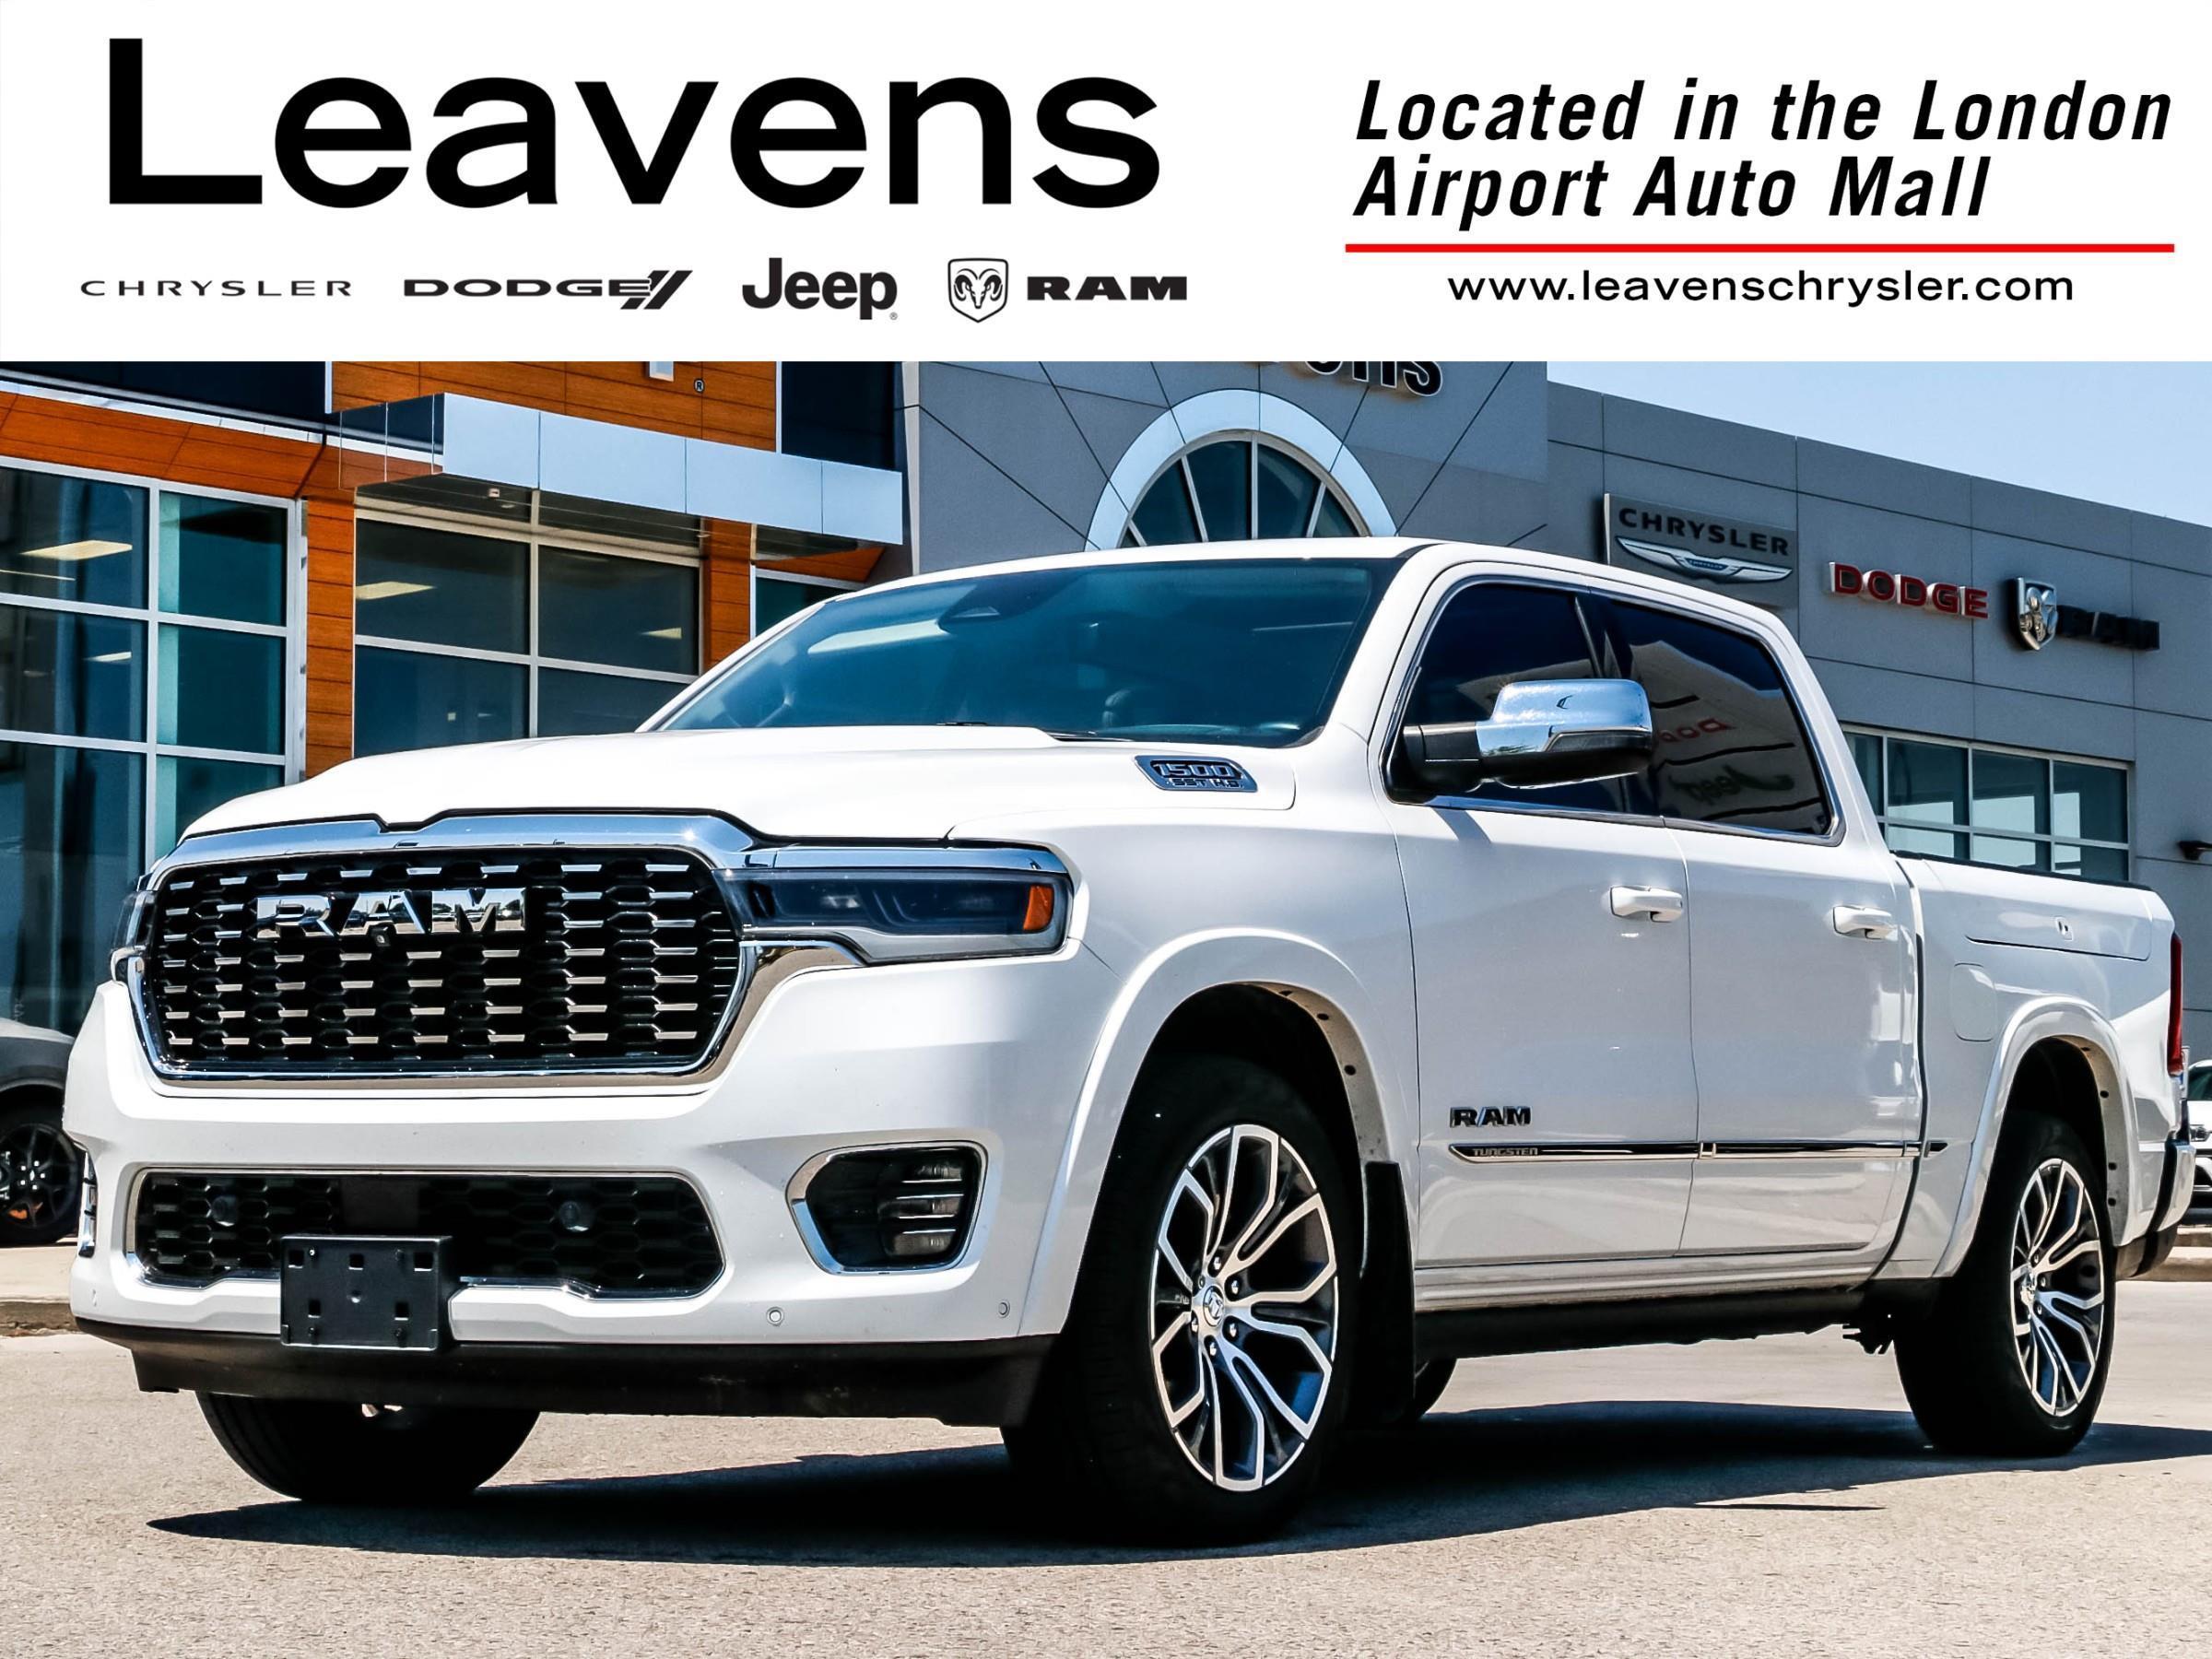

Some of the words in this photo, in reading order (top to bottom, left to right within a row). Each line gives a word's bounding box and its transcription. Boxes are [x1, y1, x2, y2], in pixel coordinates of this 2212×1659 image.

[1618, 507, 1789, 556] CHRYSLER
[1829, 560, 1989, 618] DODGE
[1153, 763, 1236, 778] 1500
[256, 888, 526, 938] RAM
[1450, 1106, 1532, 1128] RAM
